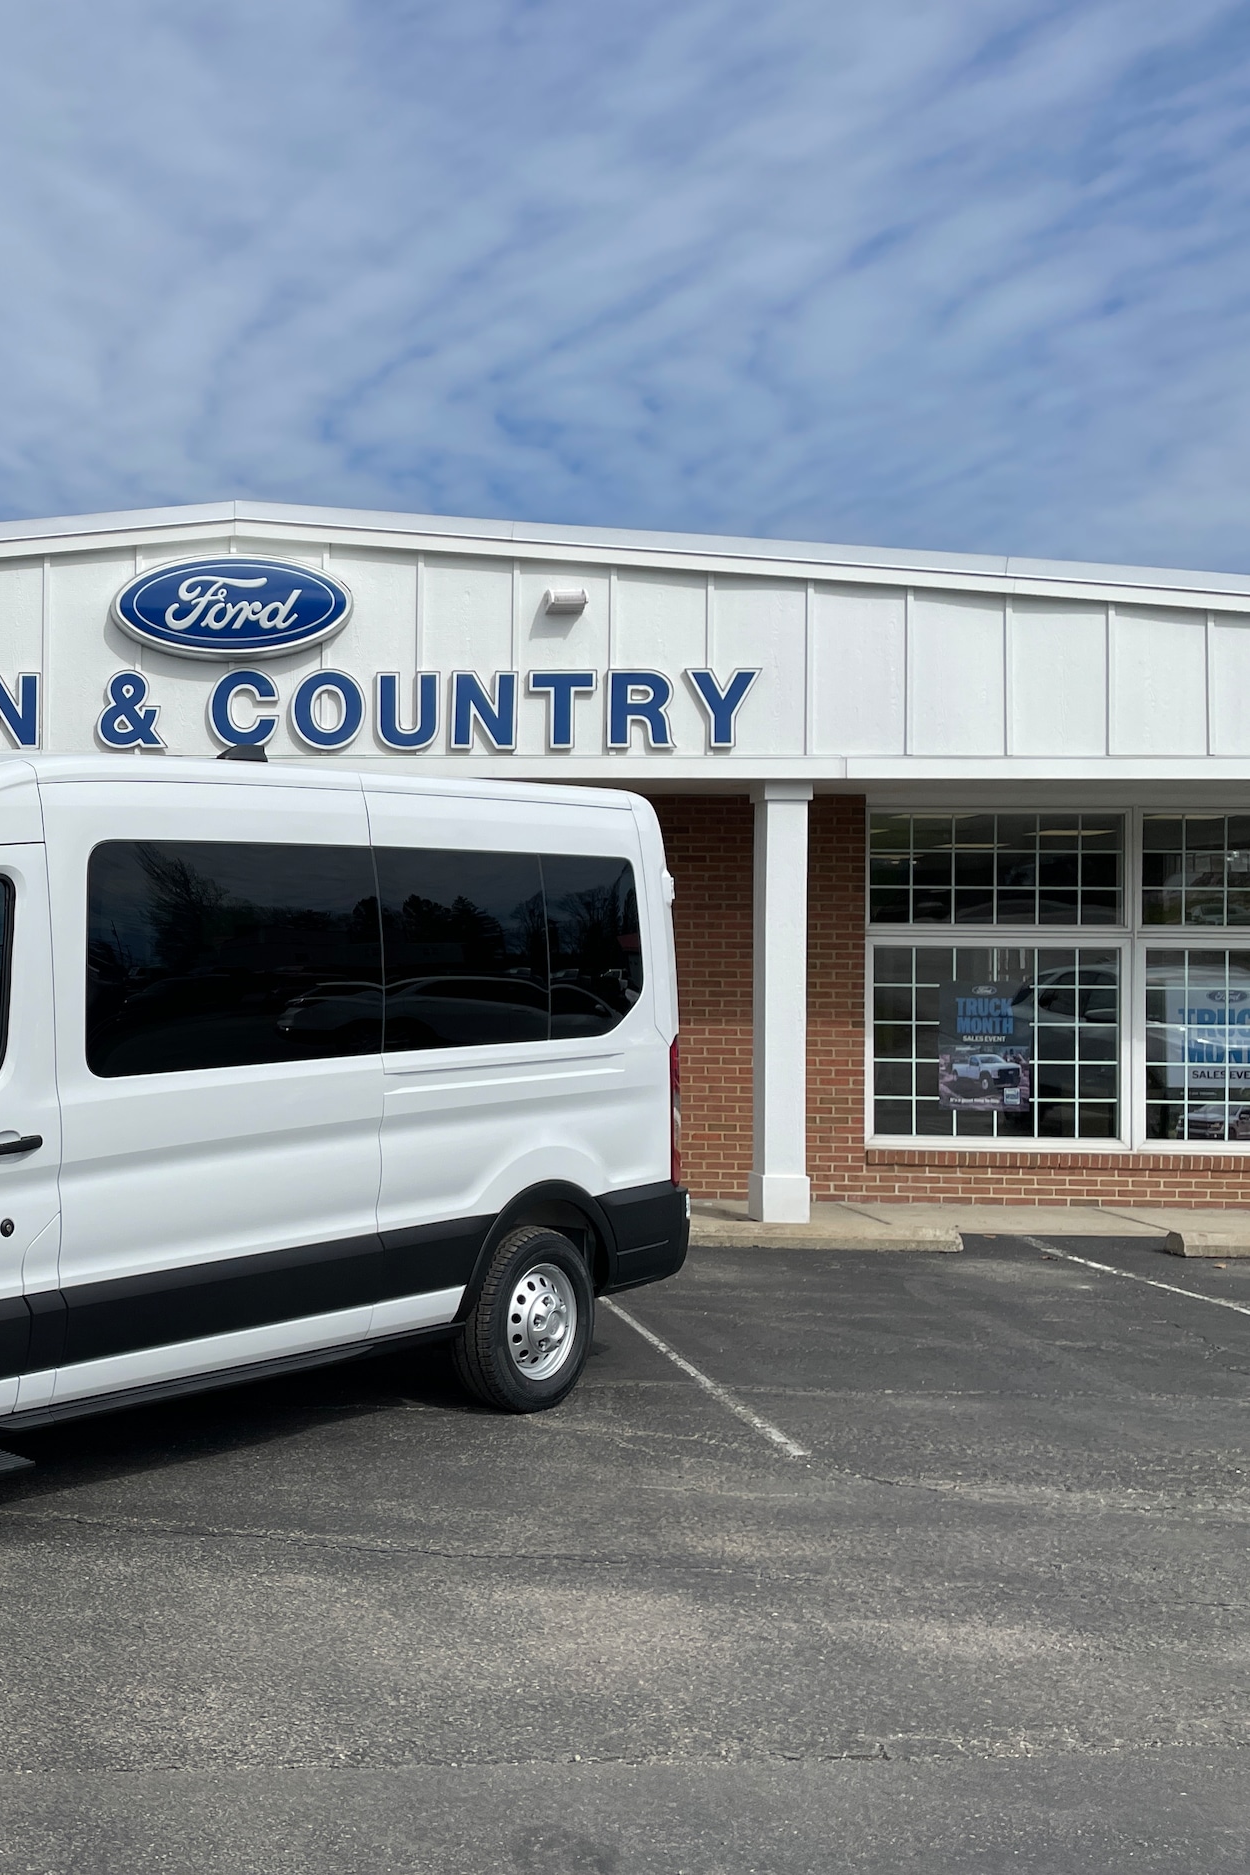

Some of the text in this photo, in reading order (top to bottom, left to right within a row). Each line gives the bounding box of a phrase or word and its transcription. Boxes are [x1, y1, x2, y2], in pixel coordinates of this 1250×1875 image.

[165, 576, 302, 630] Ford
[97, 670, 167, 749] &
[208, 668, 762, 750] COUNTRY
[956, 997, 1013, 1016] TRUCK
[957, 1017, 1014, 1034] MONTH
[1181, 1039, 1250, 1063] MON
[1192, 1070, 1226, 1080] SALES
